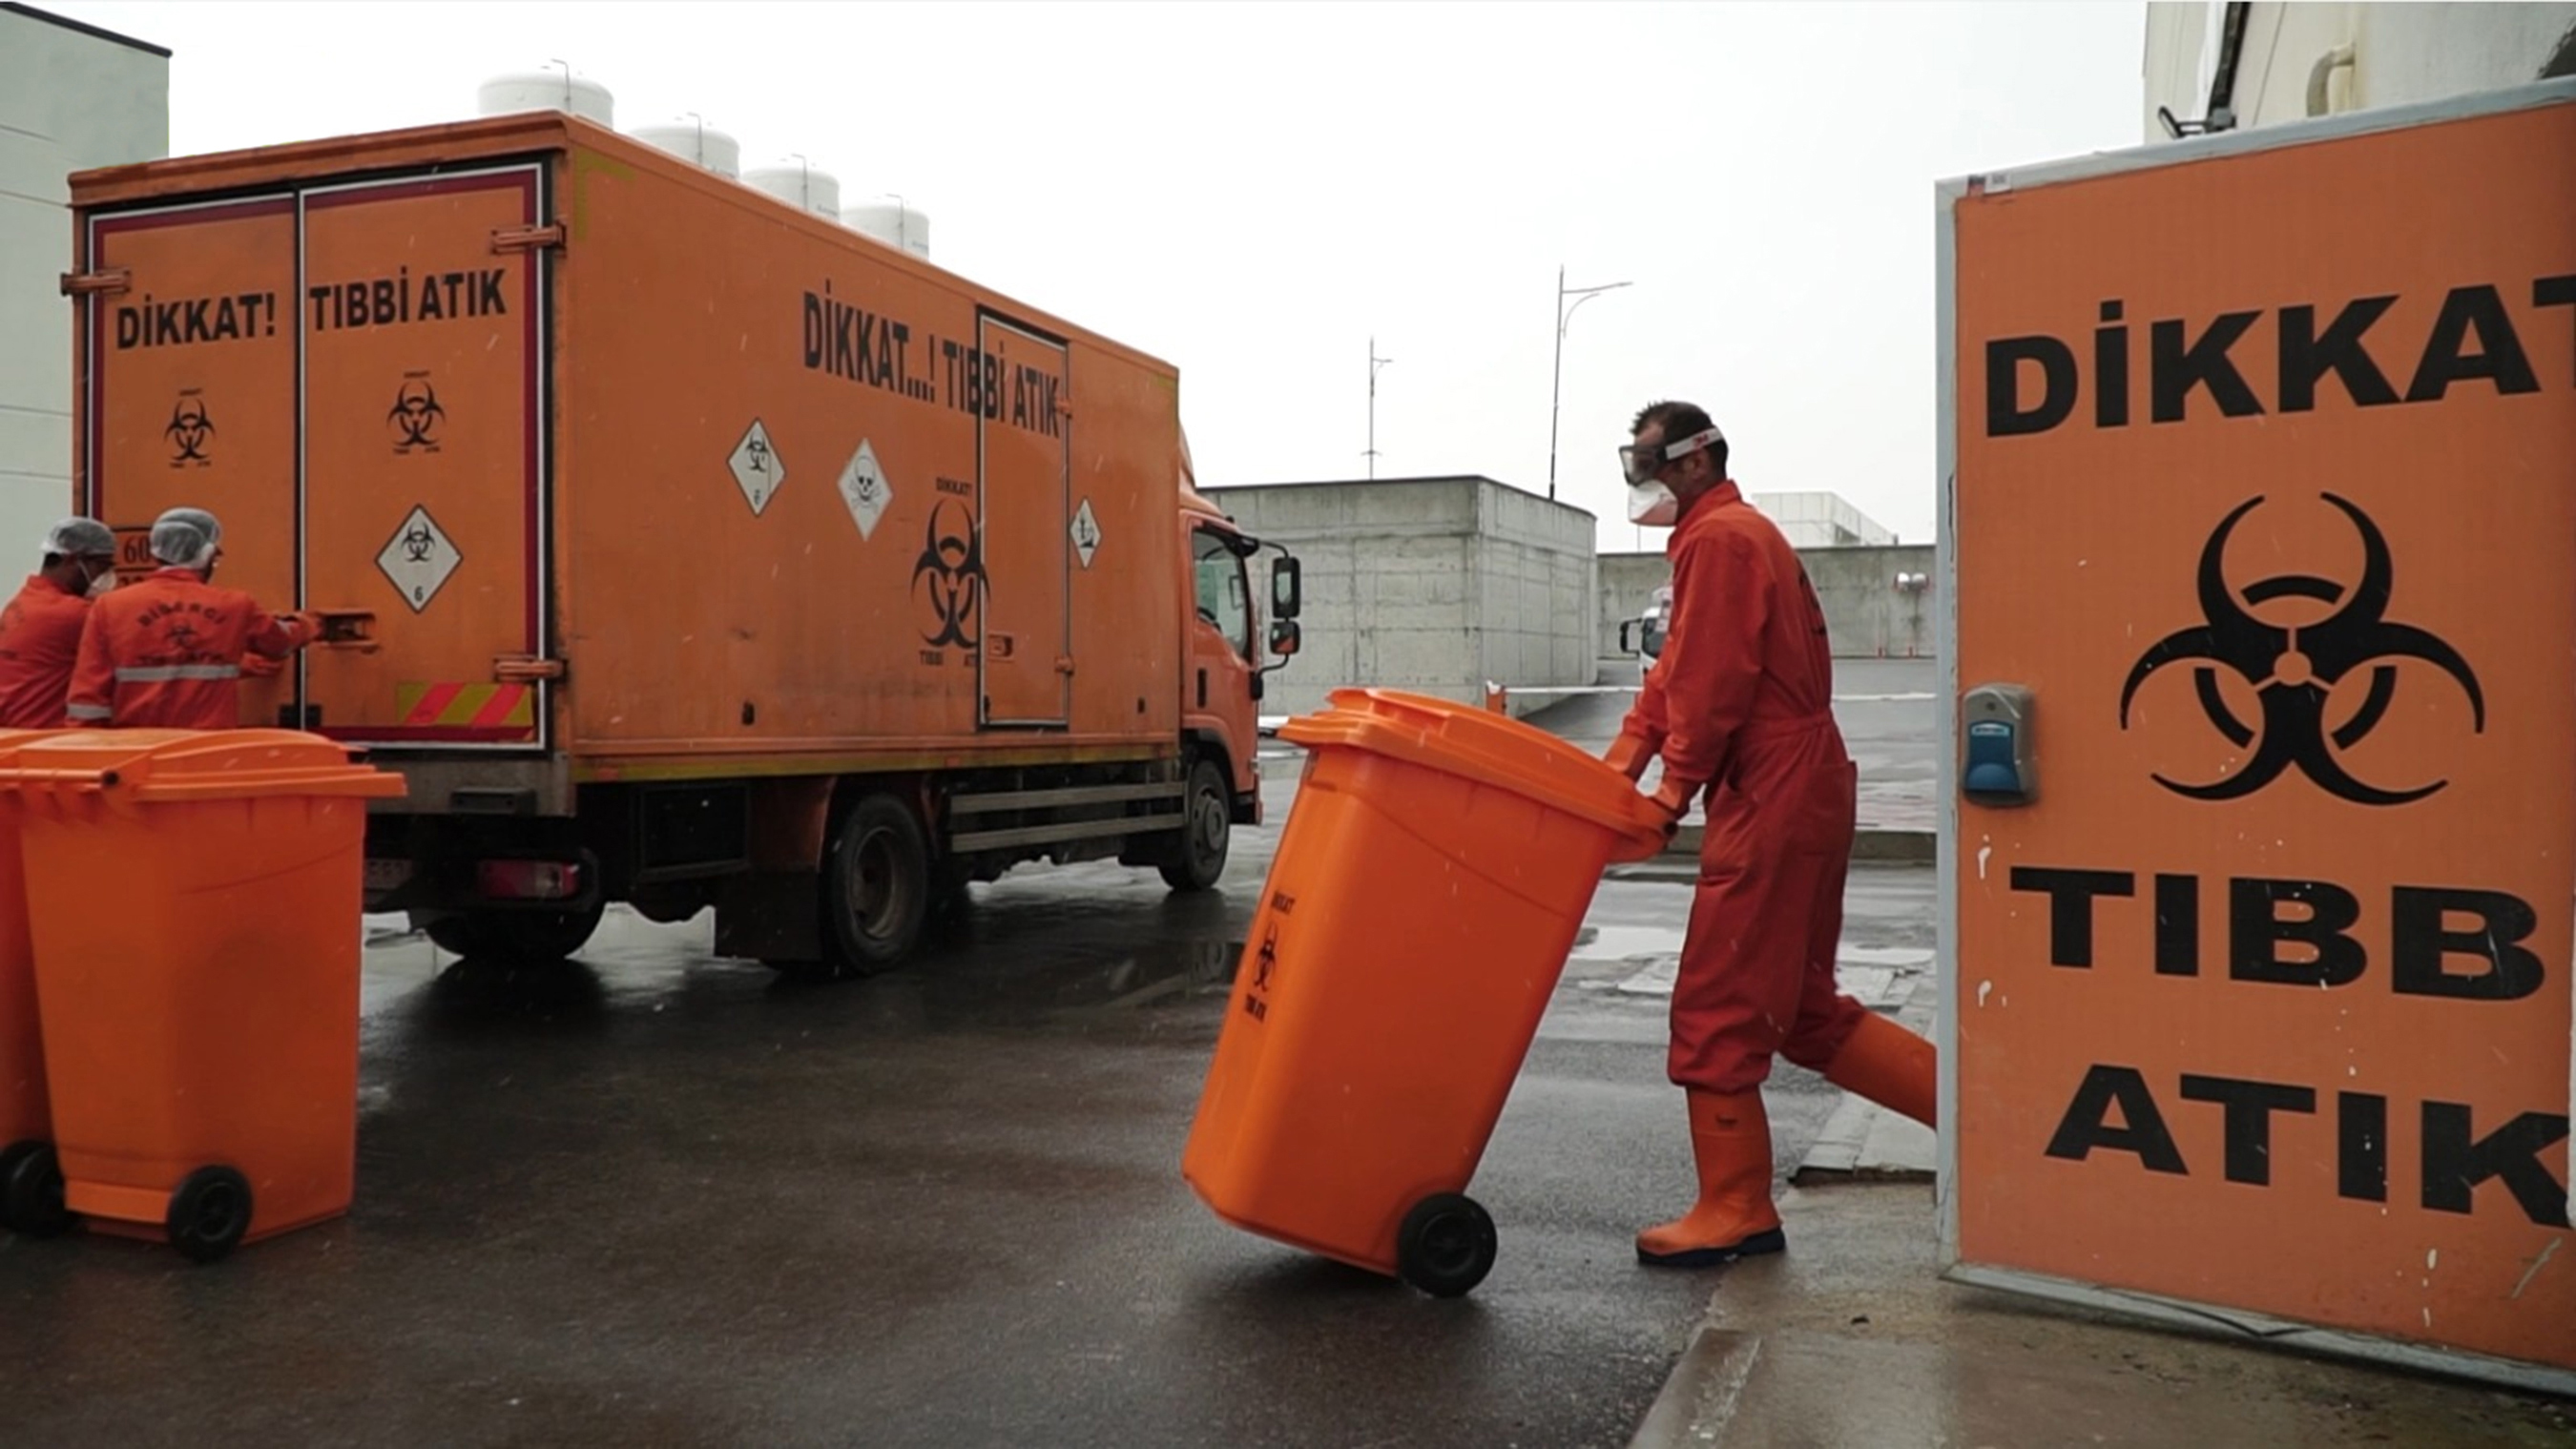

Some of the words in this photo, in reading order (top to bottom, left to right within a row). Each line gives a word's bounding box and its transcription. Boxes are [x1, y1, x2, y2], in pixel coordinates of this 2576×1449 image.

[117, 292, 275, 349] DİKKAT!
[309, 265, 408, 331] TIBBİ
[418, 268, 507, 321] ATIK
[943, 339, 1006, 423] TIBBİ
[1012, 363, 1060, 439] ATIK
[414, 585, 424, 602] 6
[2044, 1064, 2574, 1229] ATIK
